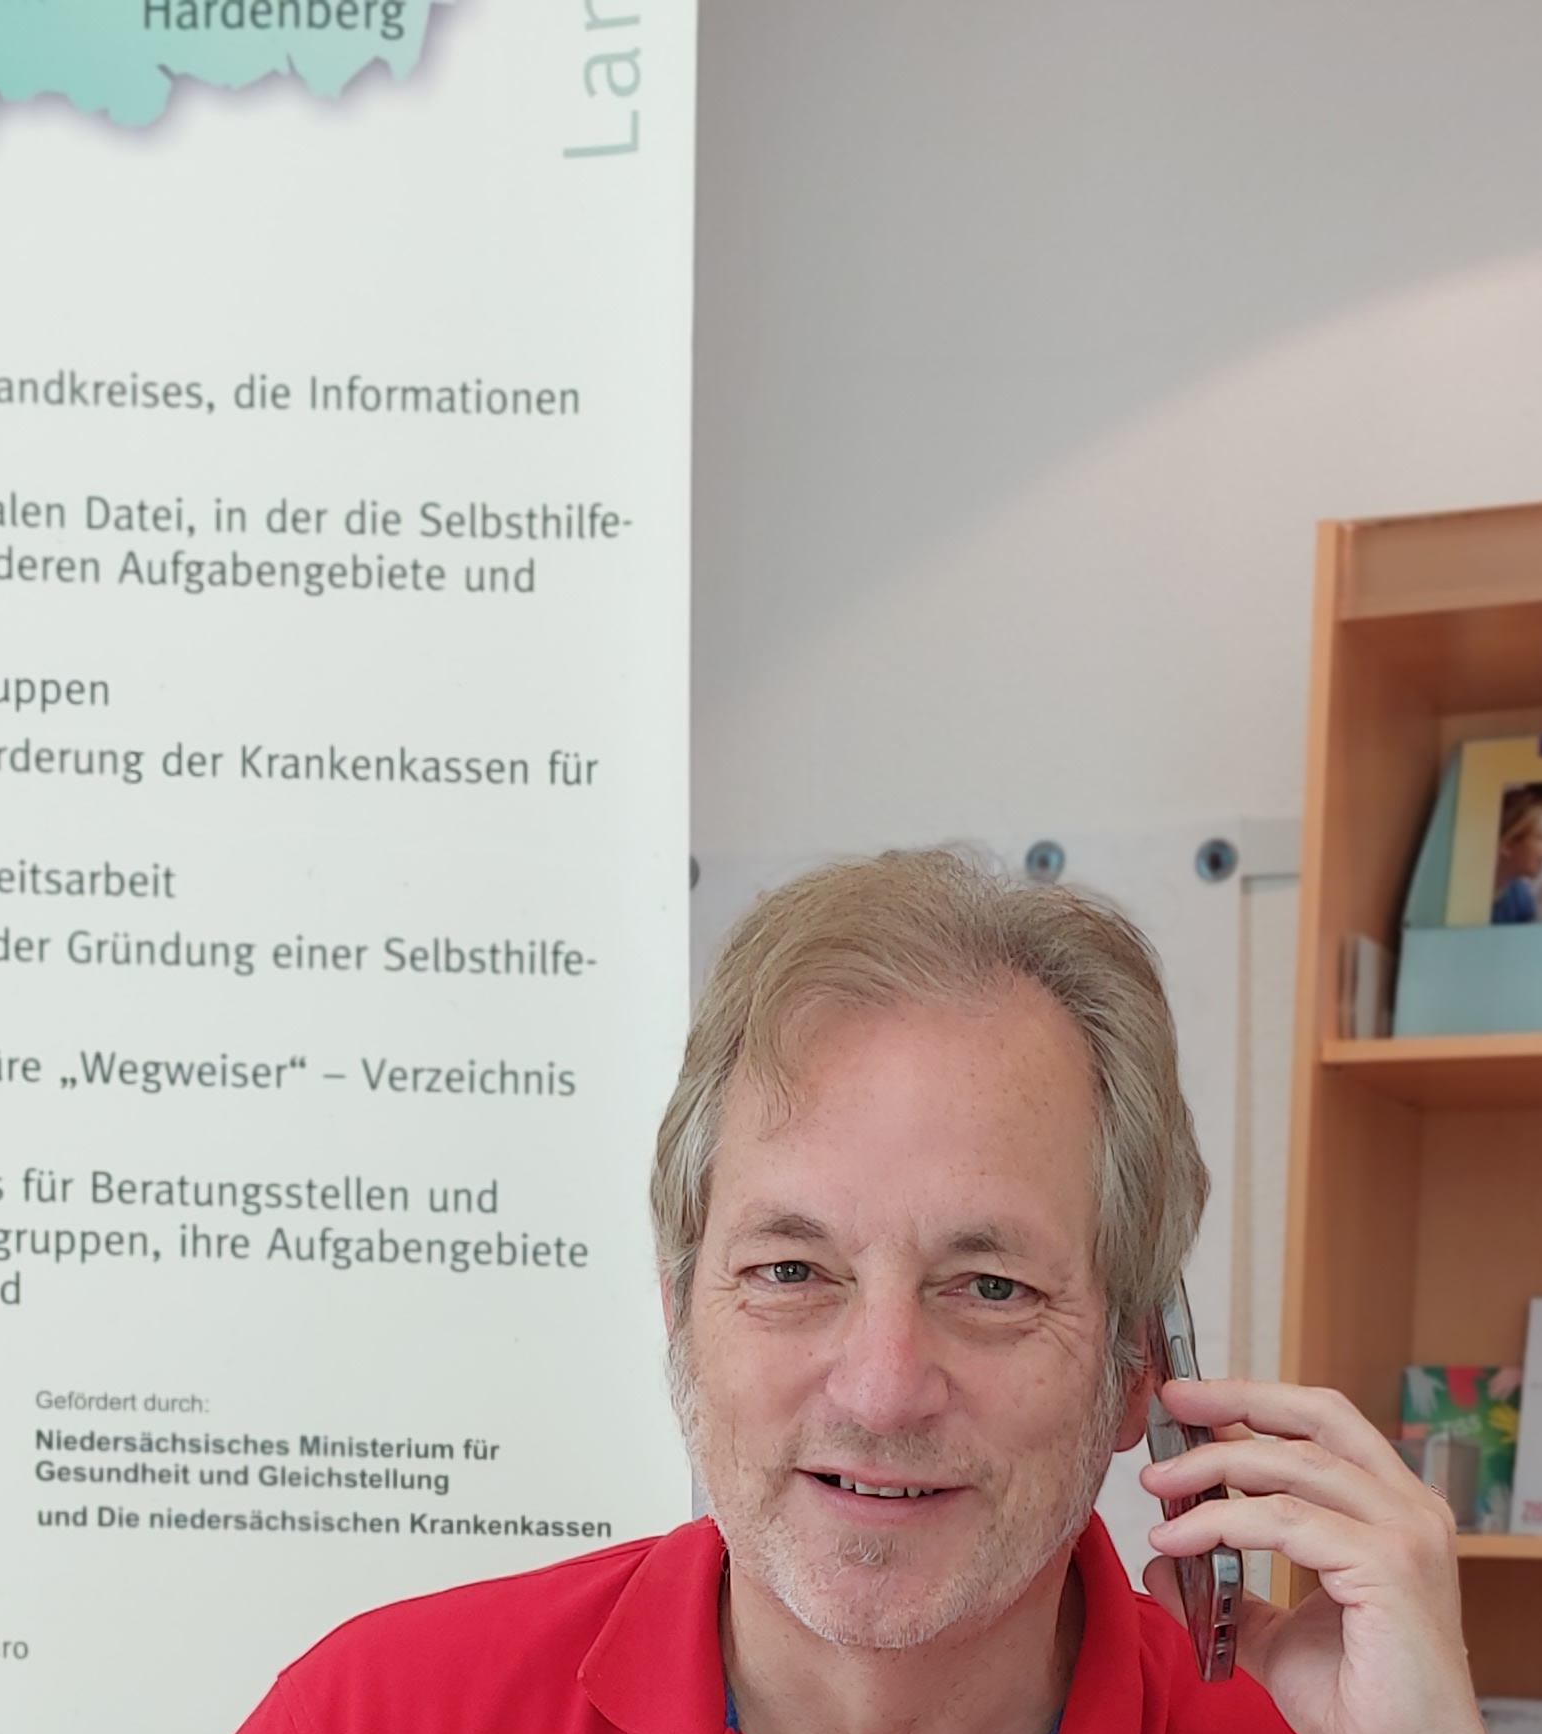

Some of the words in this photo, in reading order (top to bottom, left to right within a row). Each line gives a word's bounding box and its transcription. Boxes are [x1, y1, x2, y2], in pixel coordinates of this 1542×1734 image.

[144, 0, 405, 41] Hardenberg
[234, 373, 291, 410] die
[311, 375, 579, 416] Informationen
[86, 495, 195, 538] Datei,
[215, 497, 246, 533] in
[266, 498, 328, 535] der
[345, 499, 402, 536] die
[420, 501, 632, 540] Selbsthilfe-
[118, 550, 446, 597] Aufgabengebiete
[465, 557, 535, 593] und
[162, 742, 224, 778] der
[241, 745, 528, 785] Krankenkassen
[548, 750, 599, 786] für
[67, 930, 256, 976] Gründung
[272, 934, 368, 971] einer
[384, 937, 597, 976] Selbsthilfe-
[60, 1051, 307, 1094] „Wegweiser“
[361, 1058, 576, 1096] Verzeichnis
[23, 1167, 74, 1203] für
[92, 1170, 408, 1216] Beratungsstellen
[429, 1179, 497, 1214] und
[180, 1223, 250, 1259] ihre
[267, 1227, 588, 1273] Aufgabengebiete
[35, 1390, 137, 1412] Gefördert
[143, 1391, 209, 1413] durch:
[36, 1429, 290, 1456] Niedersächsisches
[299, 1435, 454, 1460] Ministerium
[463, 1438, 500, 1461] für
[35, 1460, 190, 1485] Gesundheit
[199, 1465, 249, 1486] und
[258, 1466, 449, 1496] Gleichstellung
[37, 1506, 88, 1527] und
[97, 1506, 140, 1528] Die
[149, 1507, 400, 1534] niedersächsischen
[410, 1513, 612, 1538] Krankenkassen
